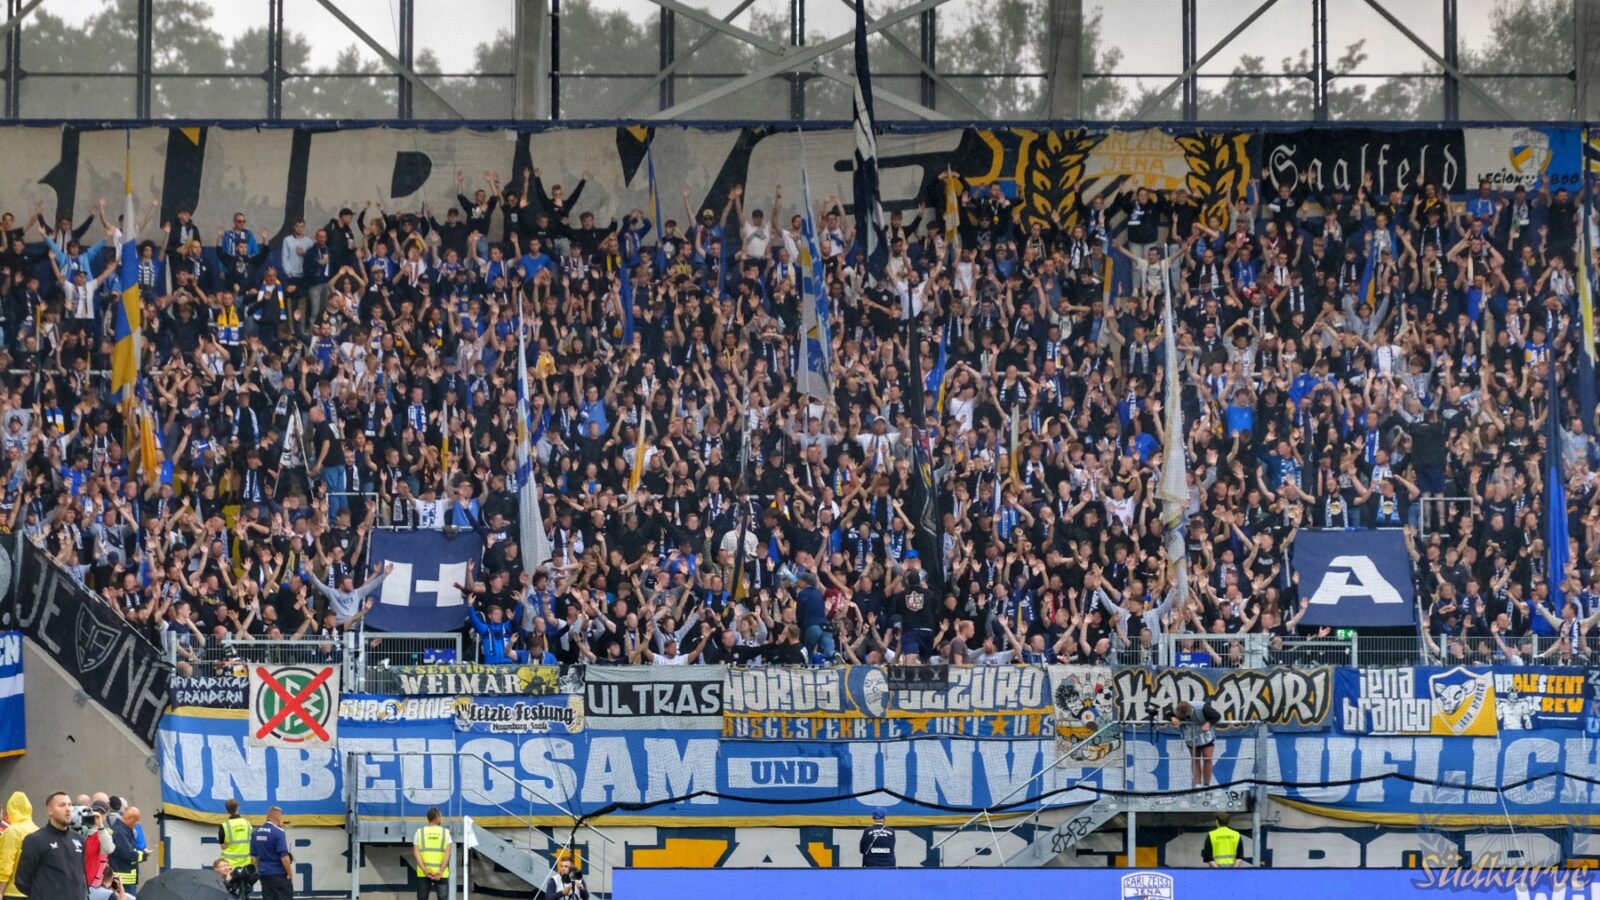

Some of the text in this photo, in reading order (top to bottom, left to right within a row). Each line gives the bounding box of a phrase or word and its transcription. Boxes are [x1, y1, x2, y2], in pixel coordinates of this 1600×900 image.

[1269, 144, 1458, 196] Saalfeld
[1309, 555, 1404, 605] A
[400, 673, 523, 695] WEIMAR
[588, 683, 721, 715] ULTRAS
[514, 702, 574, 726] Festung
[723, 714, 1055, 739] AUSGESPERRTE MIT UNS
[161, 729, 720, 806] UNBEUGSAM
[750, 760, 820, 786] UND
[1132, 888, 1162, 896] JENA
